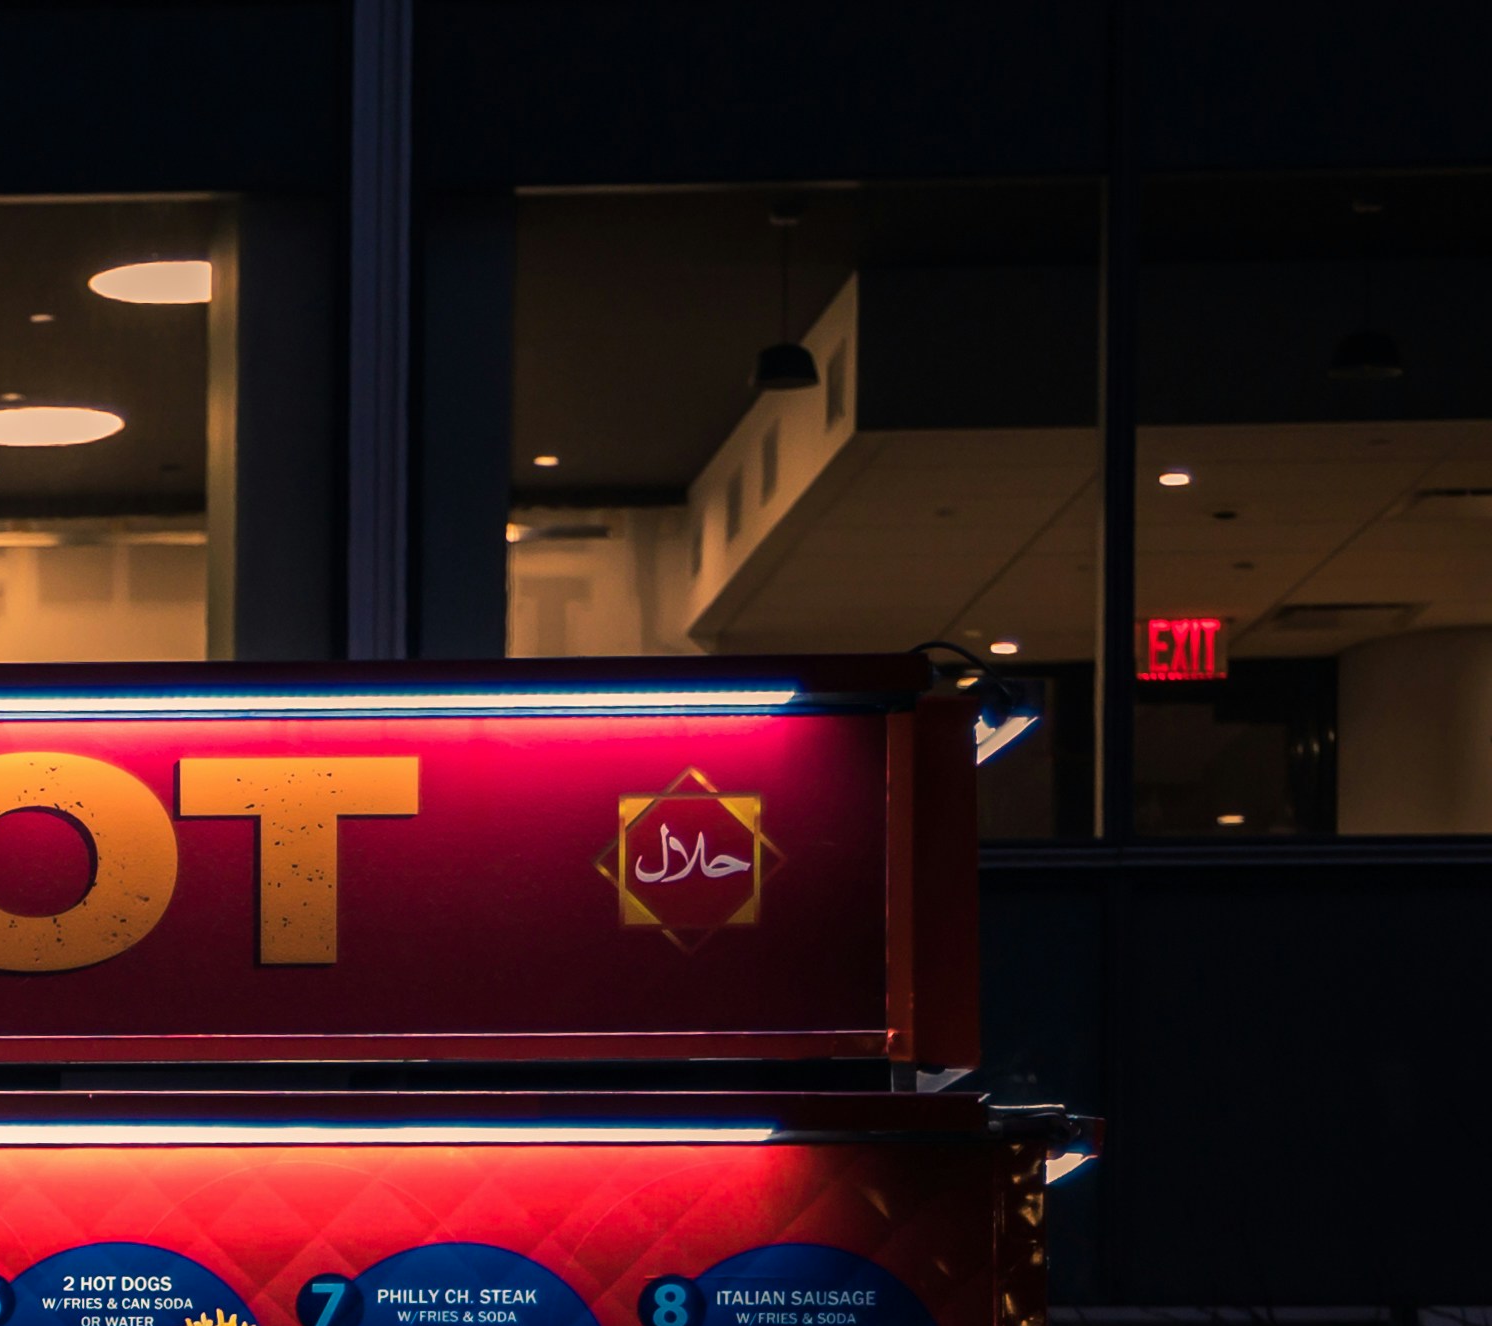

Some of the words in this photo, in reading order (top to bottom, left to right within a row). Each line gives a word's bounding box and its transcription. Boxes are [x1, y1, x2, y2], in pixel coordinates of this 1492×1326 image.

[1149, 618, 1221, 673] EXIT
[634, 823, 752, 884] حلال
[62, 1275, 75, 1292] 2
[80, 1275, 117, 1292] HOT
[121, 1275, 173, 1292] DOGS
[41, 1297, 103, 1310] W/FRIES
[106, 1297, 118, 1310] &
[121, 1297, 151, 1310] CAN
[154, 1297, 194, 1310] SODA
[377, 1288, 440, 1304] PHILLY
[444, 1288, 473, 1304] CH.
[479, 1288, 537, 1305] STEAK
[716, 1290, 785, 1306] ITALIAN
[791, 1290, 875, 1306] SAUSAGE
[397, 1309, 460, 1323] W/FRIES
[462, 1310, 476, 1323] &
[478, 1310, 517, 1323] SODA
[735, 1312, 799, 1325] W/FRIES
[801, 1312, 815, 1325] &
[817, 1312, 857, 1325] SODA
